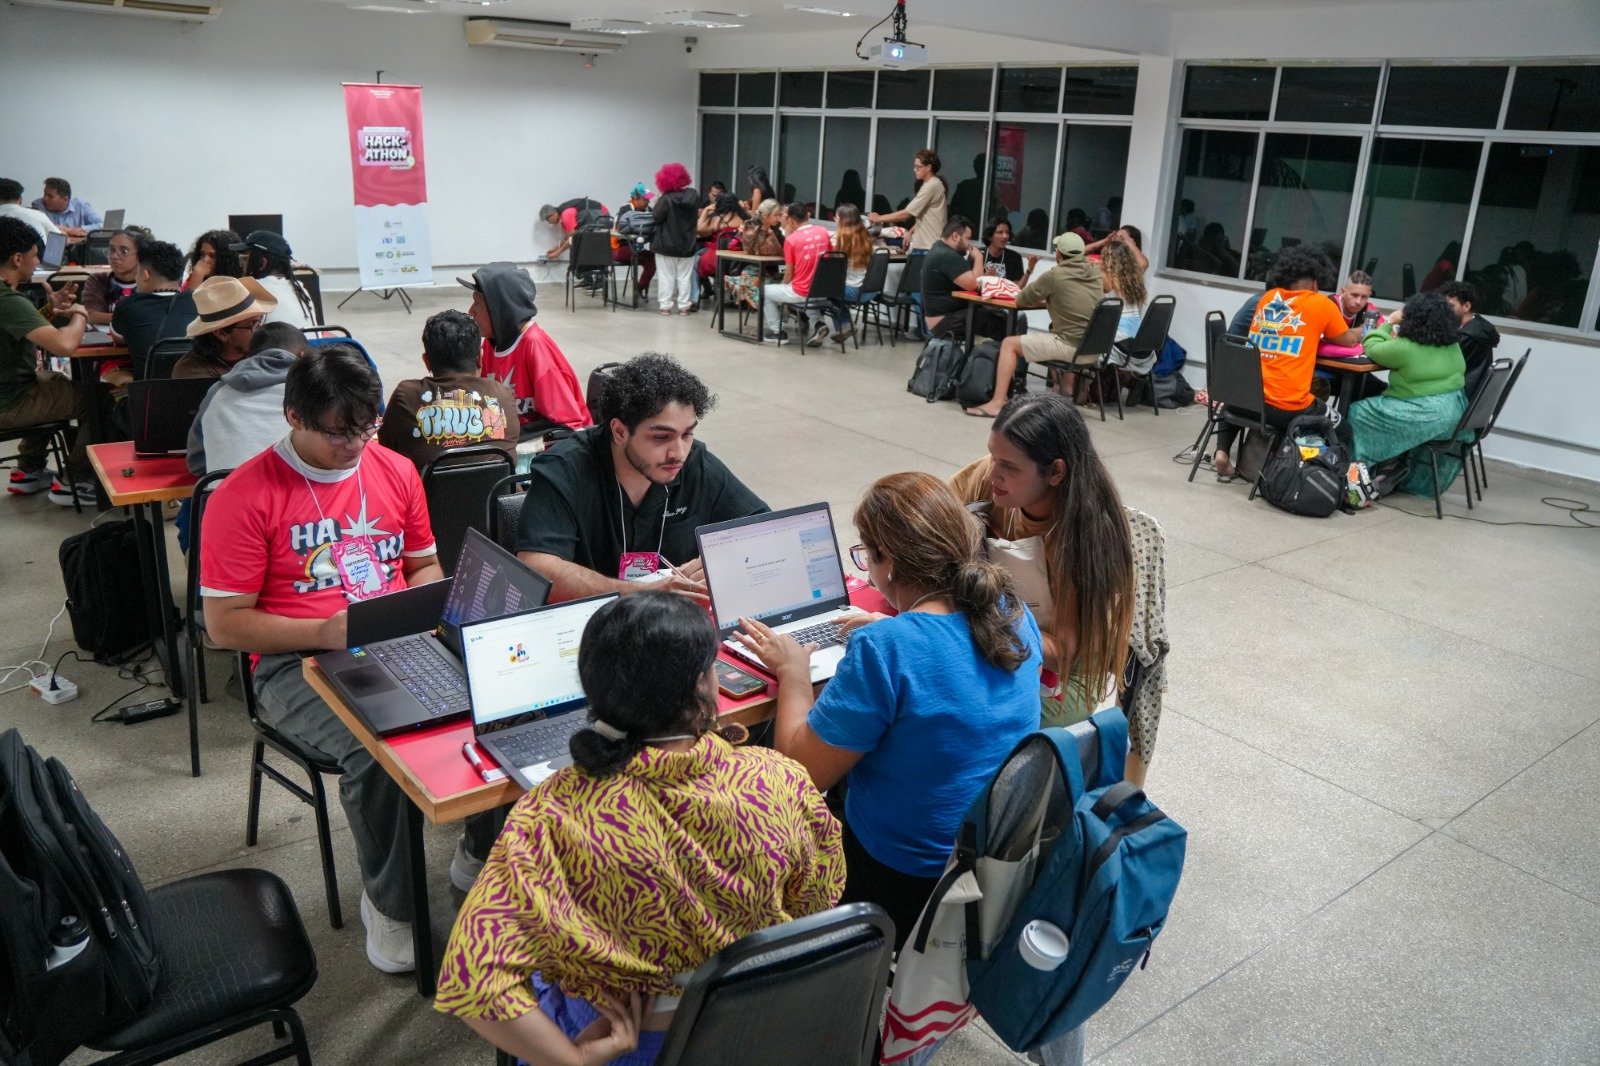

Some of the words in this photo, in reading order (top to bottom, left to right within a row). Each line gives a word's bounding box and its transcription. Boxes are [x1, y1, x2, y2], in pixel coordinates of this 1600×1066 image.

[364, 135, 408, 147] HACK-
[365, 148, 408, 160] ATHON
[418, 405, 484, 437] THUG
[290, 518, 339, 552] HA
